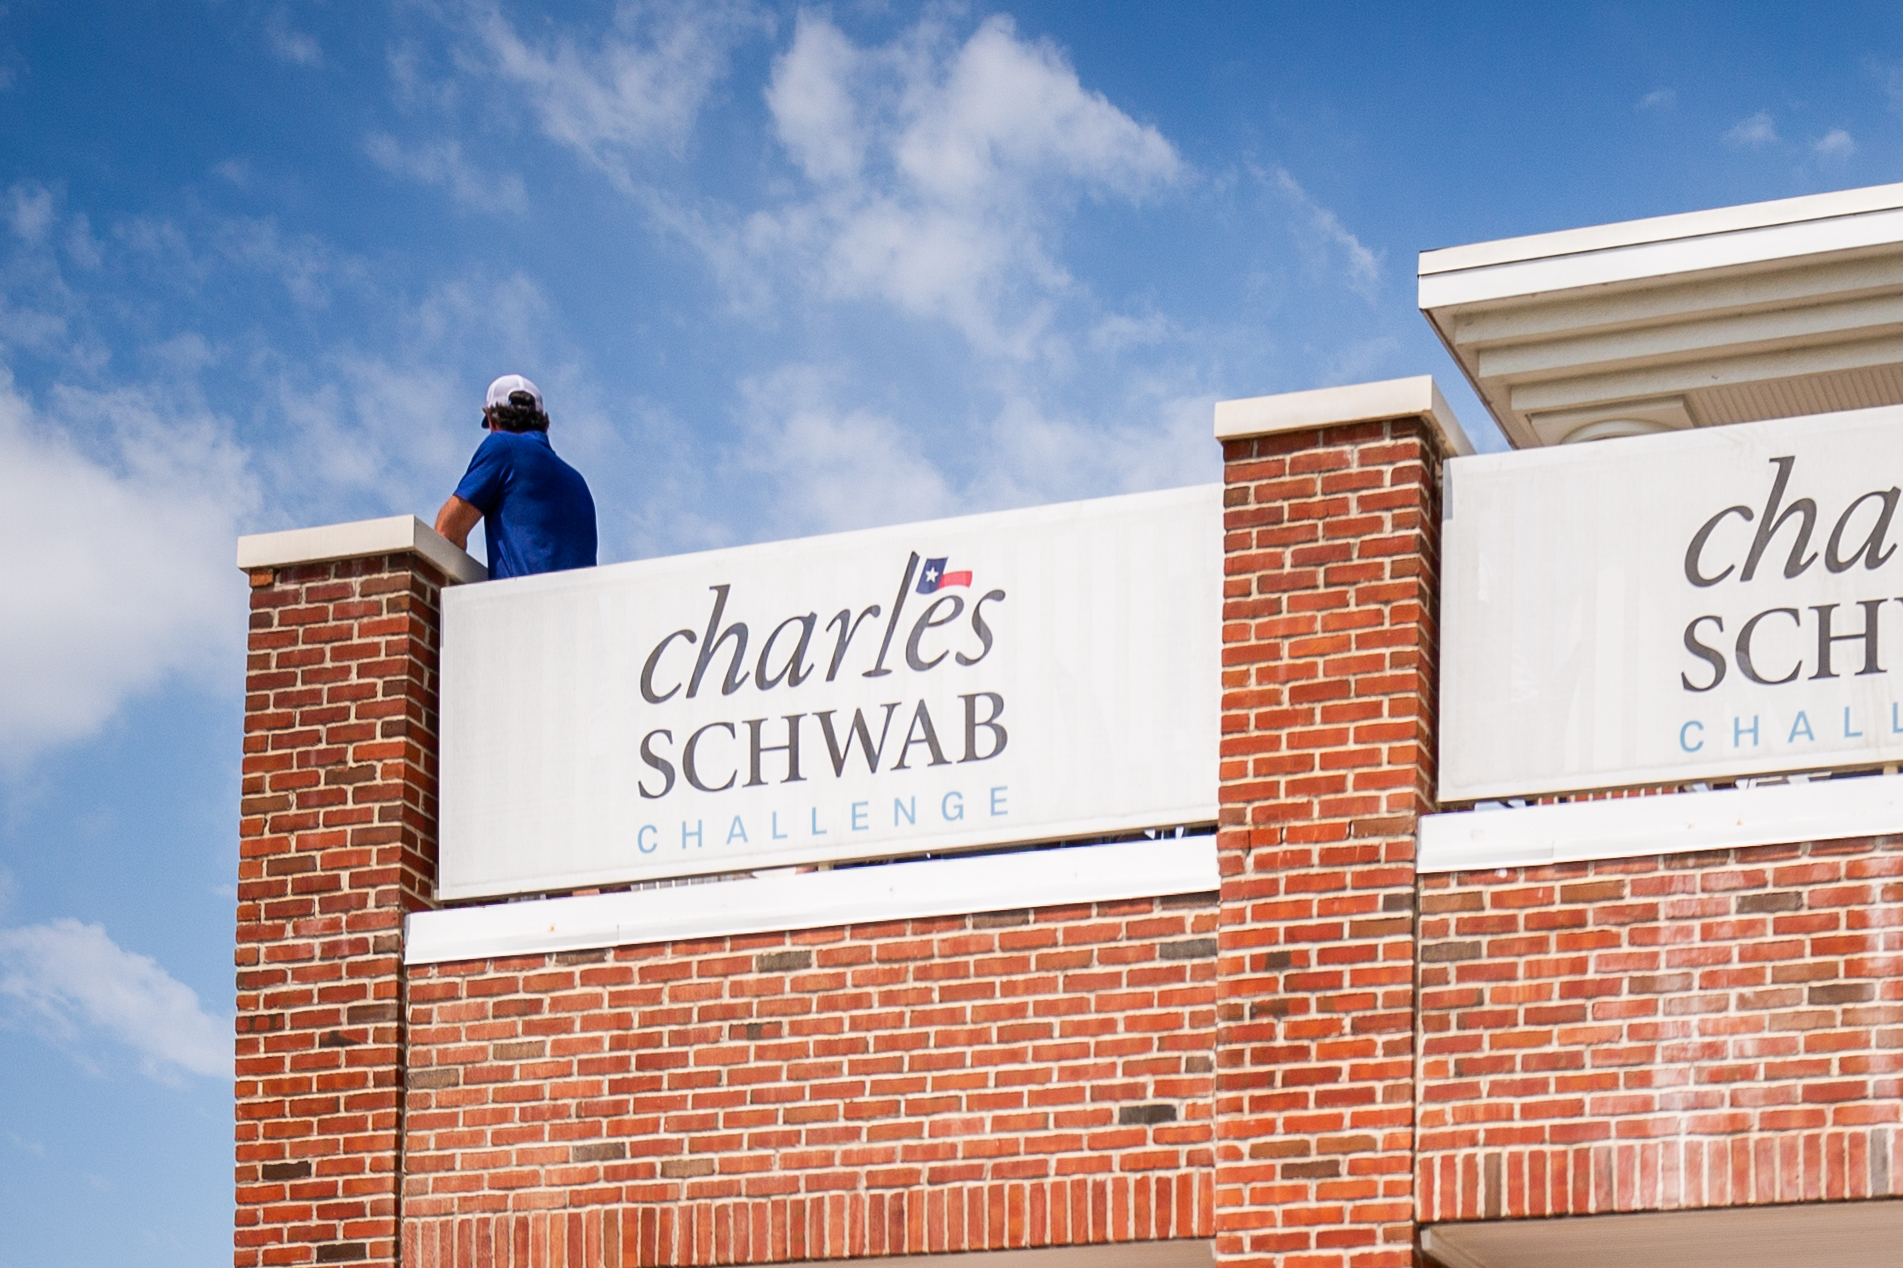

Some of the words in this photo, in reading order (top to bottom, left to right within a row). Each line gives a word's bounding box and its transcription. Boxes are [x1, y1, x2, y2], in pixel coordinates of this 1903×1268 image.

[639, 551, 1006, 705] charles
[637, 690, 1008, 800] SCHWAB
[636, 785, 1010, 856] CHALLENGE
